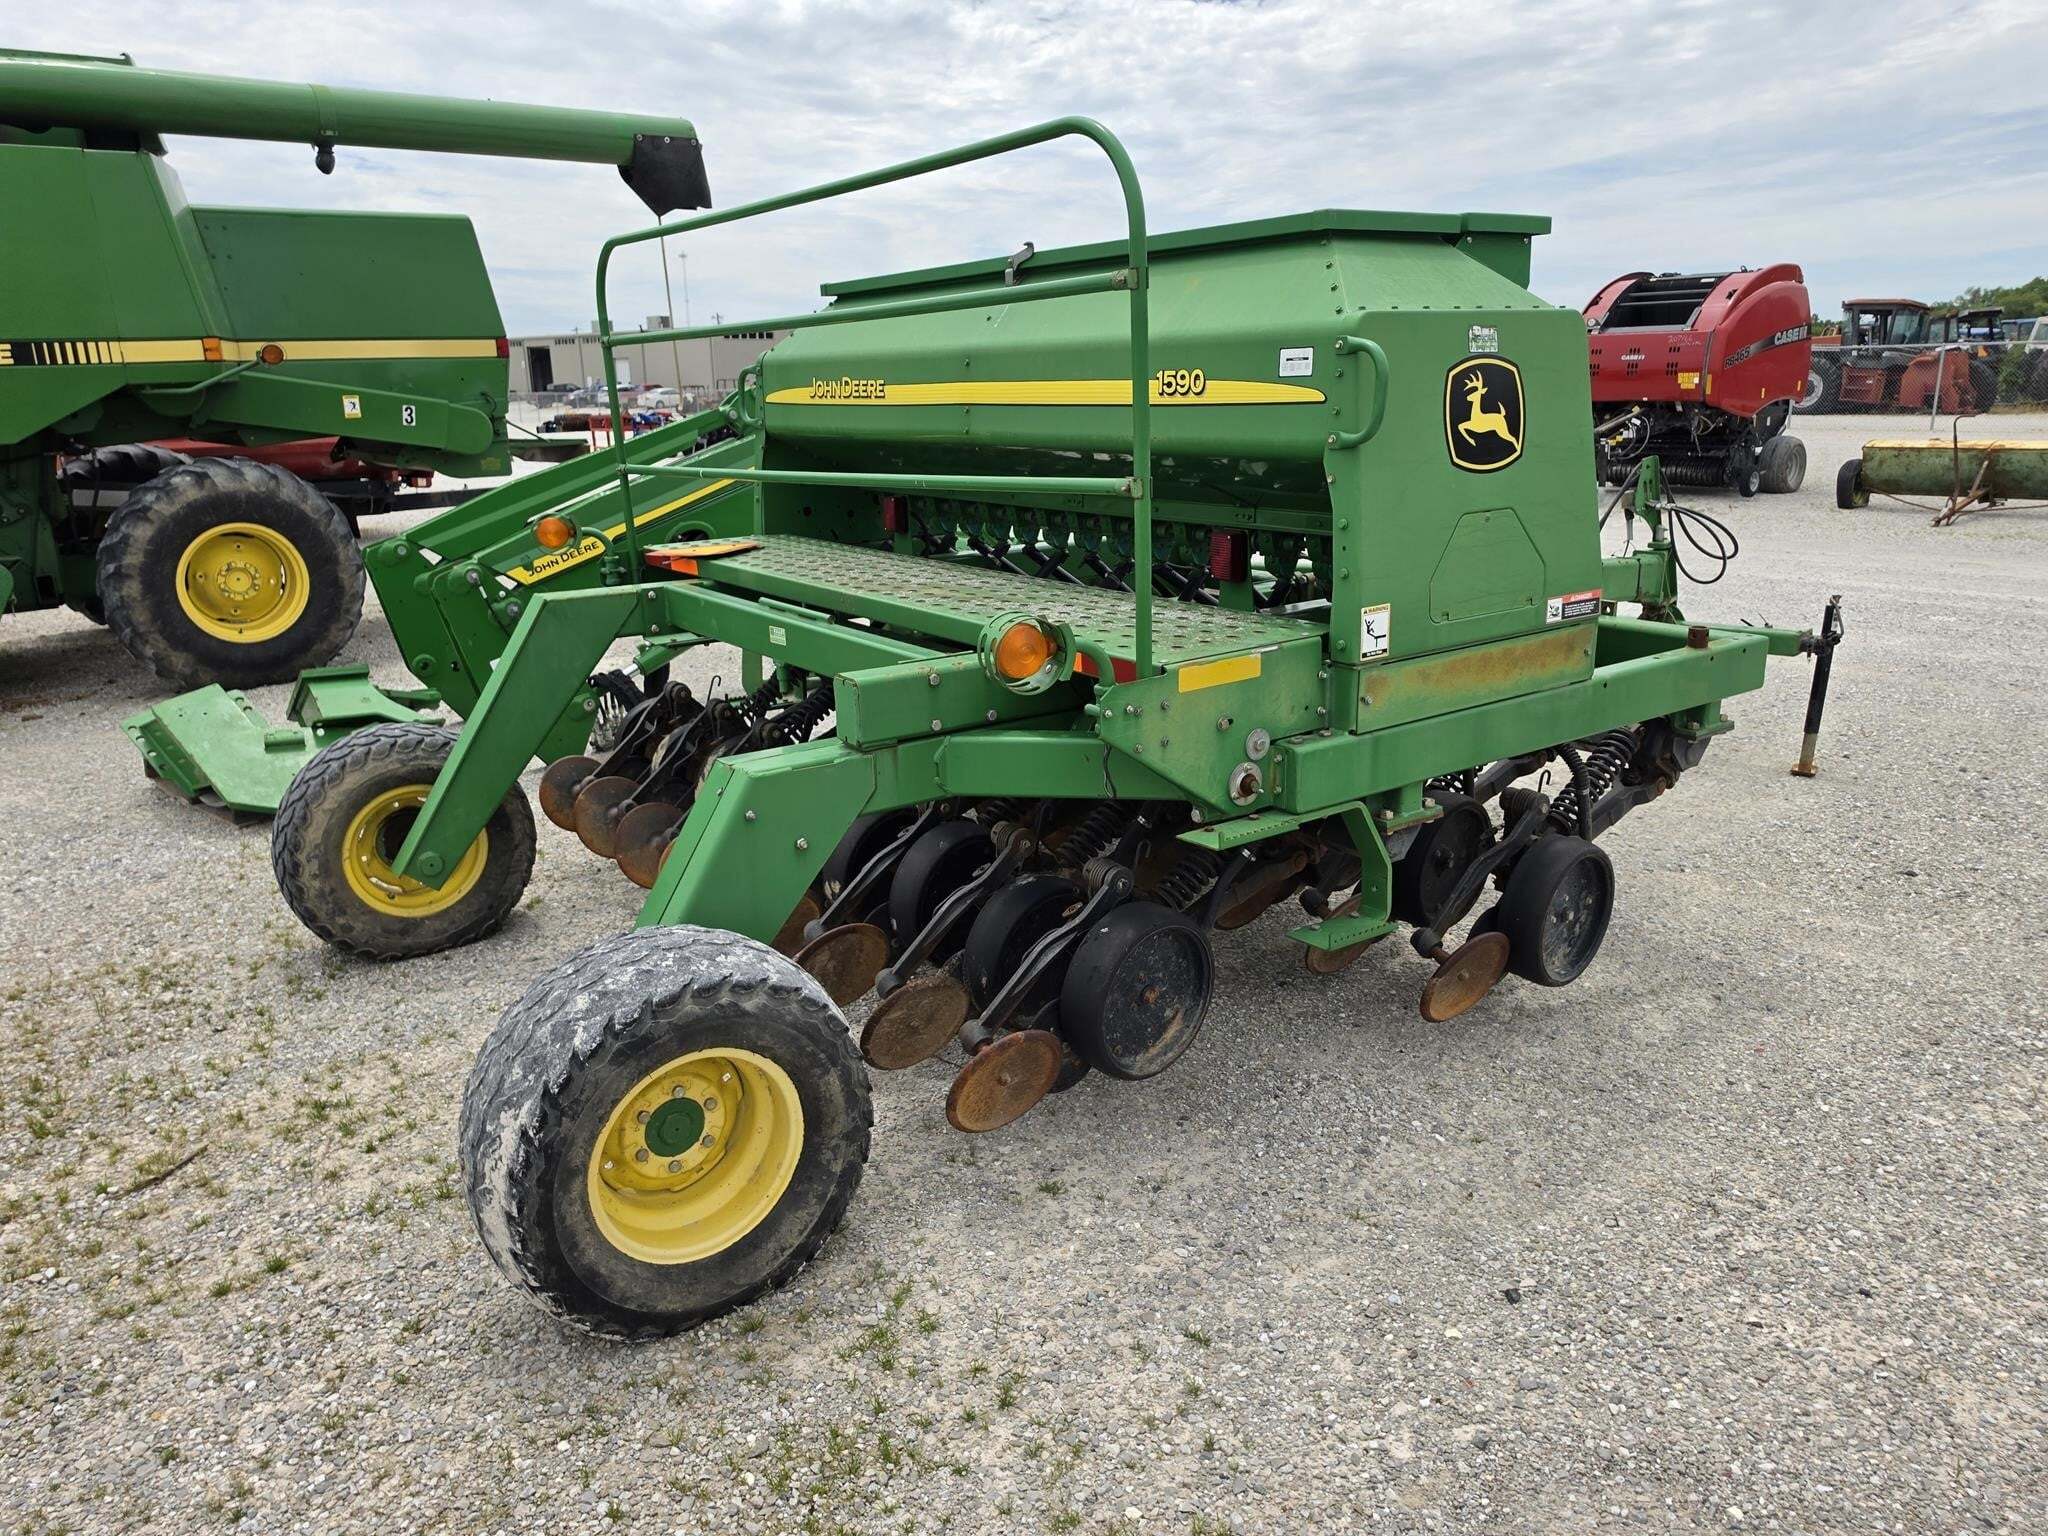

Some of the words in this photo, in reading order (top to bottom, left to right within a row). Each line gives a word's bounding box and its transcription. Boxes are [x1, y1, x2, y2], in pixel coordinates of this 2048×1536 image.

[1156, 368, 1206, 396] 1590
[404, 406, 413, 424] 3
[529, 558, 559, 577] JOHN
[560, 540, 600, 562] DEERE
